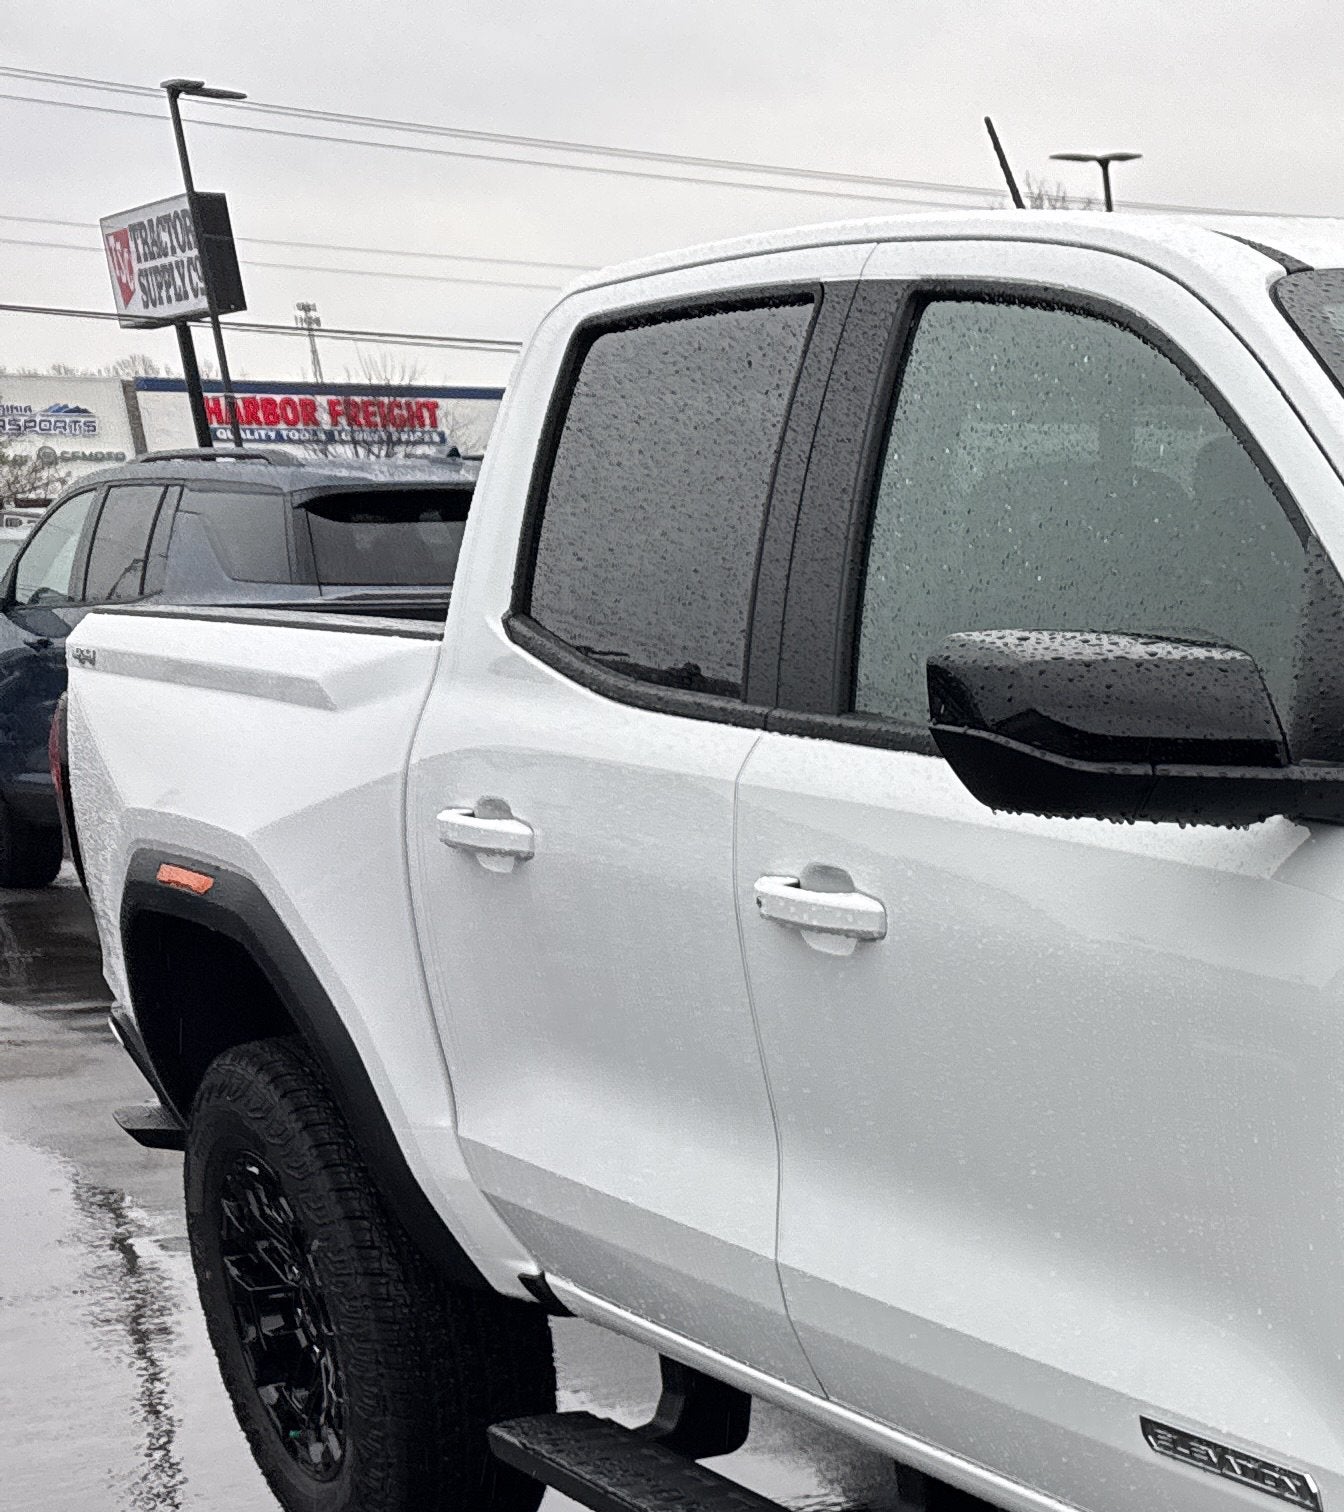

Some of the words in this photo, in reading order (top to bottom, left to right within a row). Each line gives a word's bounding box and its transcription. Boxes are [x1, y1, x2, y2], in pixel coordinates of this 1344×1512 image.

[127, 208, 199, 264] TRACTOR
[138, 259, 189, 309] SUPPLY
[204, 395, 320, 427] HARBOR
[326, 398, 438, 430] FREIGHT
[216, 428, 276, 440] QUALITY
